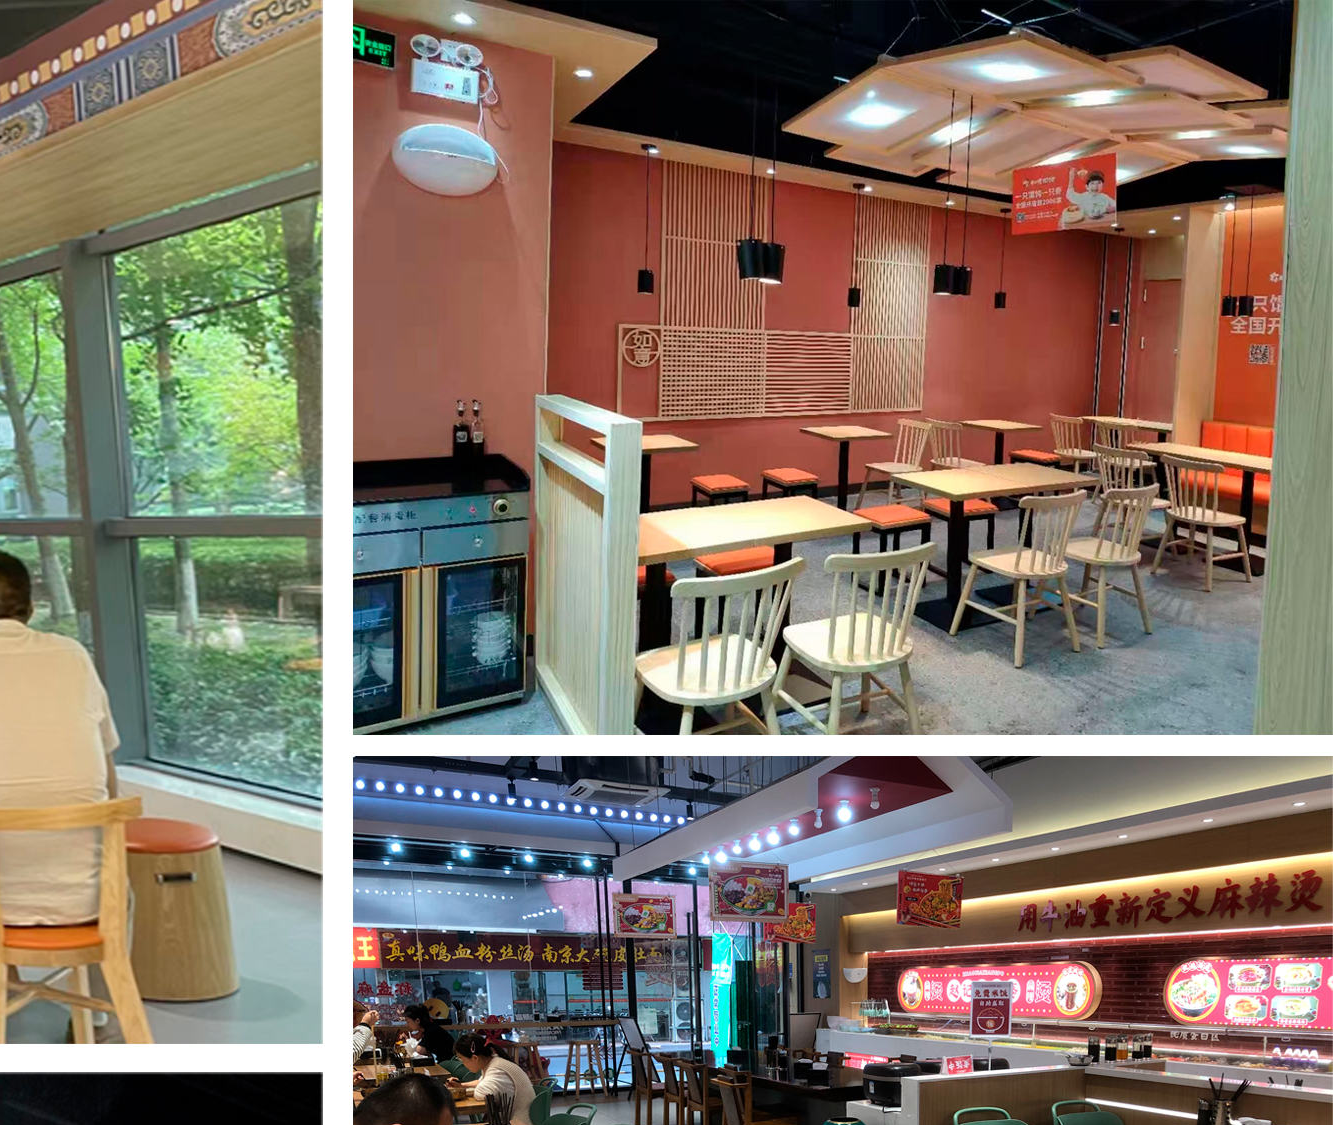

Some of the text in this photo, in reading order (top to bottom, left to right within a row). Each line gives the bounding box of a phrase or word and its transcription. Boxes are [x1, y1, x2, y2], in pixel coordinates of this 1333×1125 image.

[368, 47, 387, 57] EXIT
[1018, 869, 1324, 933] 用牛油重新定义麻辣烫
[385, 941, 535, 963] 真味鸭血粉丝汤
[974, 988, 1009, 998] 免费米饭
